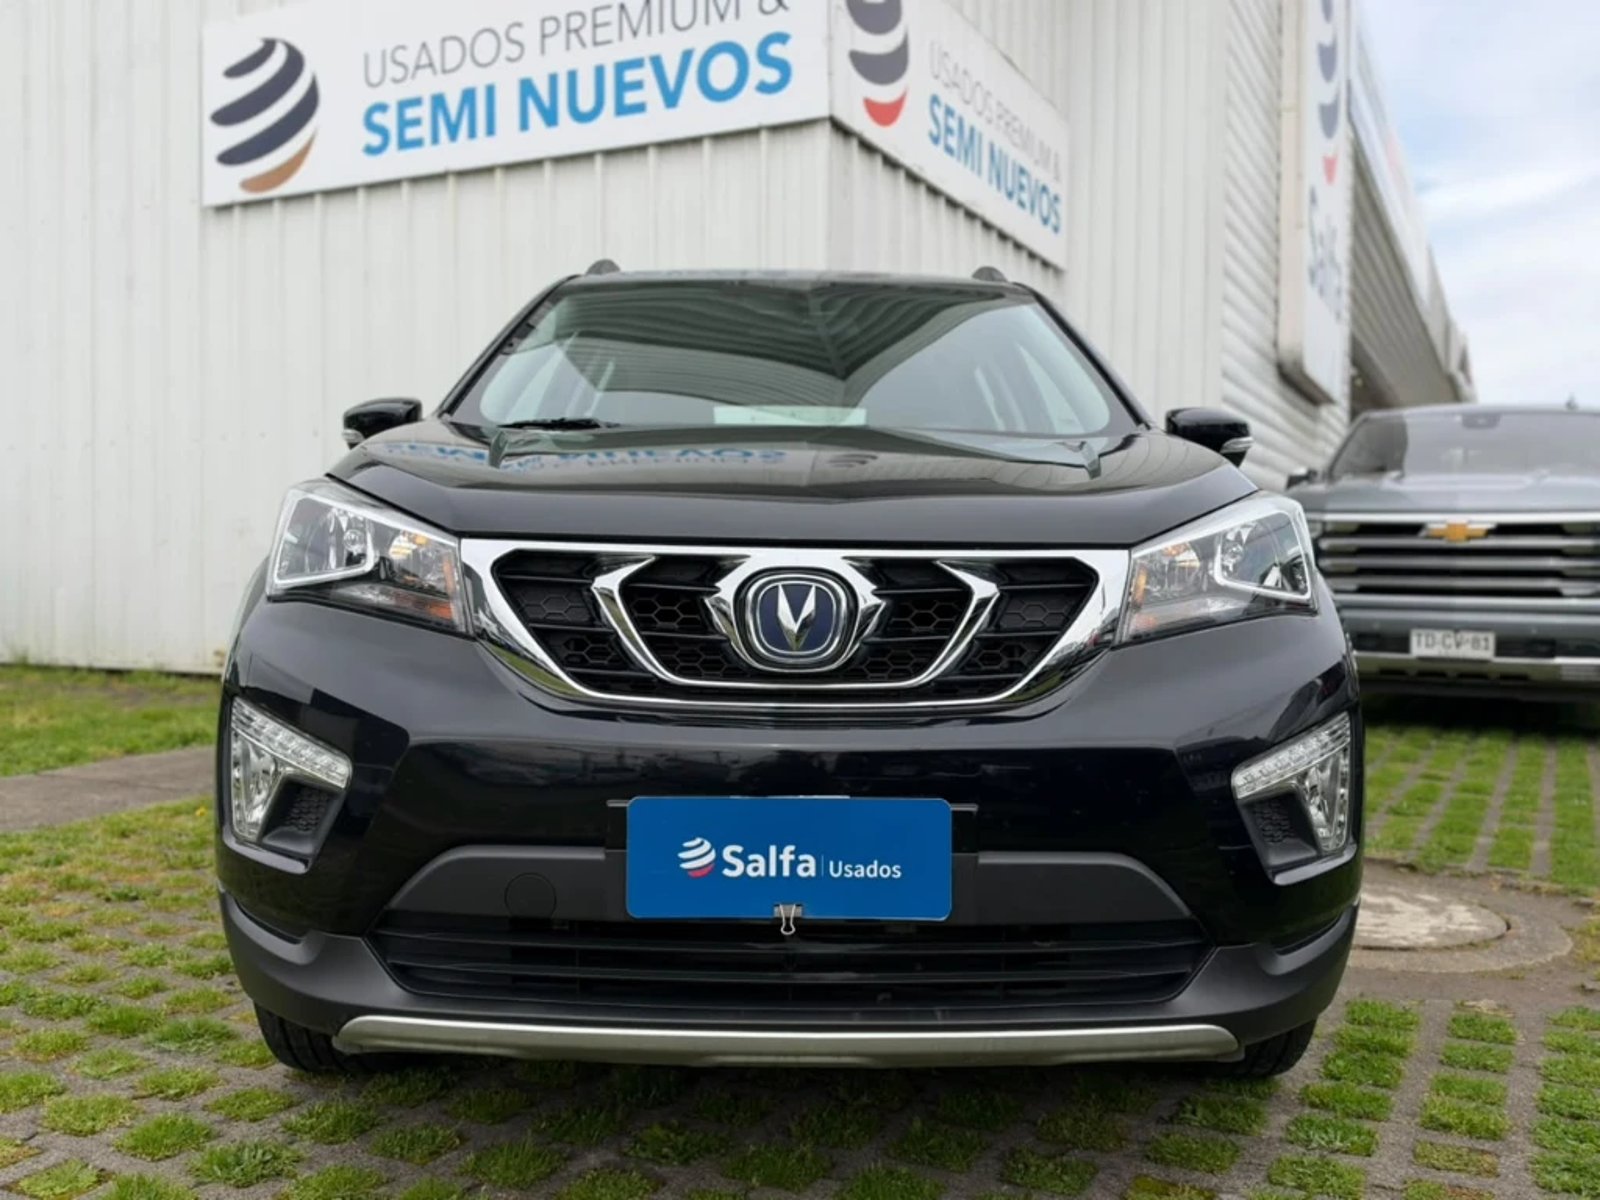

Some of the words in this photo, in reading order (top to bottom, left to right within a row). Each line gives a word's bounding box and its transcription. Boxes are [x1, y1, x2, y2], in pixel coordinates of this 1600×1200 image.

[363, 21, 526, 89] USADOS
[539, 0, 741, 56] PREMIUM
[929, 39, 993, 125] USADOS
[362, 83, 496, 157] SEMI
[518, 31, 793, 133] NUEVOS
[928, 93, 983, 179] SEMI
[987, 139, 1062, 236] NUEVOS
[721, 844, 817, 878] Salfa
[828, 860, 903, 879] Usados
